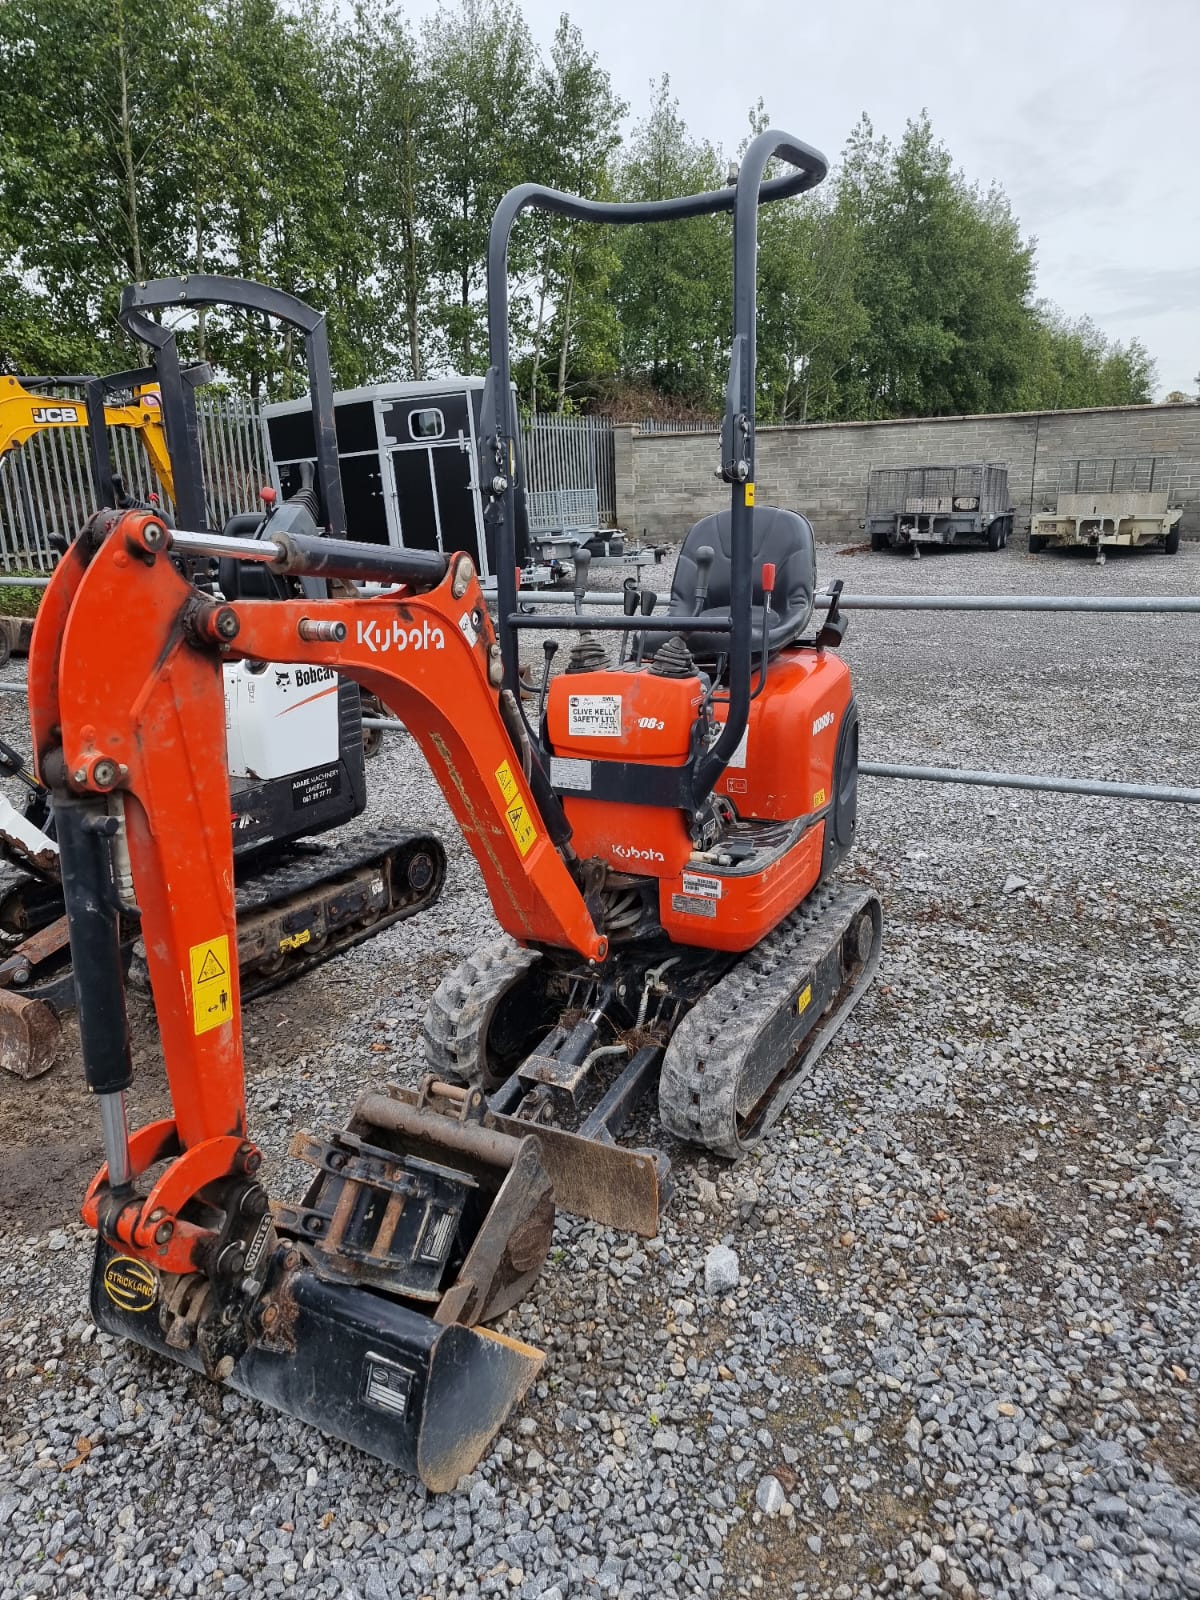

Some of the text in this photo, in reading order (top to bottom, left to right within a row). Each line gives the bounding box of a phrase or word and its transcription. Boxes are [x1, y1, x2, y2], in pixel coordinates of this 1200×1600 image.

[33, 408, 78, 423] JCB
[356, 620, 445, 652] Kubota
[572, 715, 600, 723] SAFETY
[594, 708, 617, 716] KELLY
[292, 769, 339, 790] ADARE MACHINERY
[305, 781, 328, 794] LIMERICK
[611, 844, 665, 862] Kubota
[246, 1216, 271, 1267] WHITES
[107, 1271, 153, 1297] STRICKLAND
